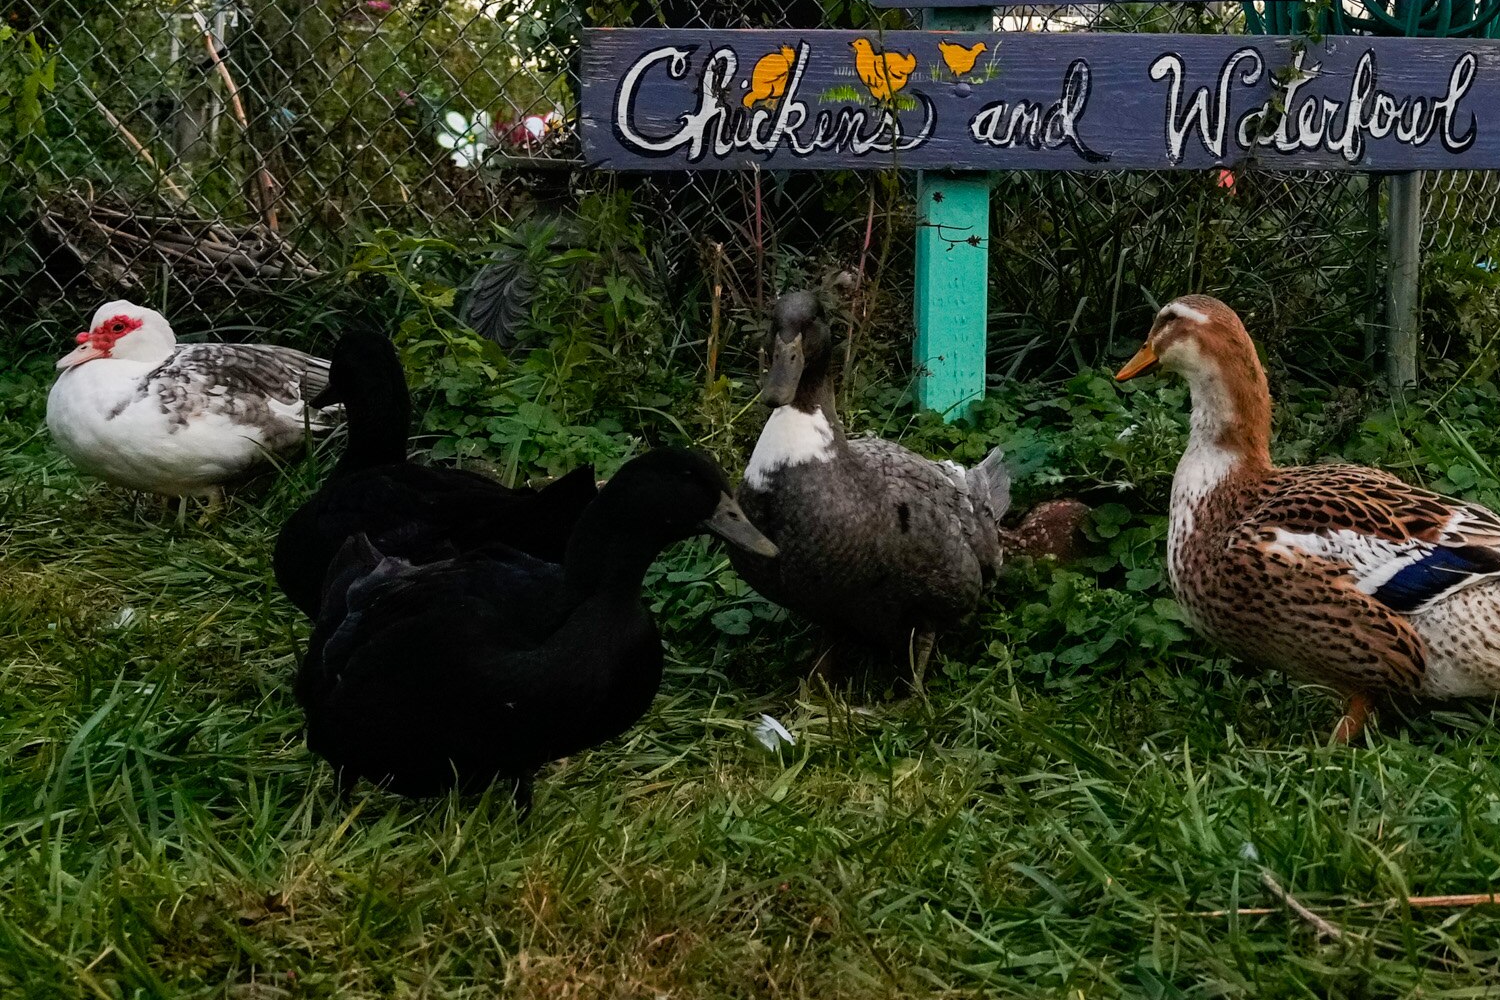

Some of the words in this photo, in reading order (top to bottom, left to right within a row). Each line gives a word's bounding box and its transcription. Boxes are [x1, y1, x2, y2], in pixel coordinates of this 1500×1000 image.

[615, 39, 937, 162] Chickens
[969, 57, 1112, 162] and
[1147, 44, 1479, 166] Waterfowl
